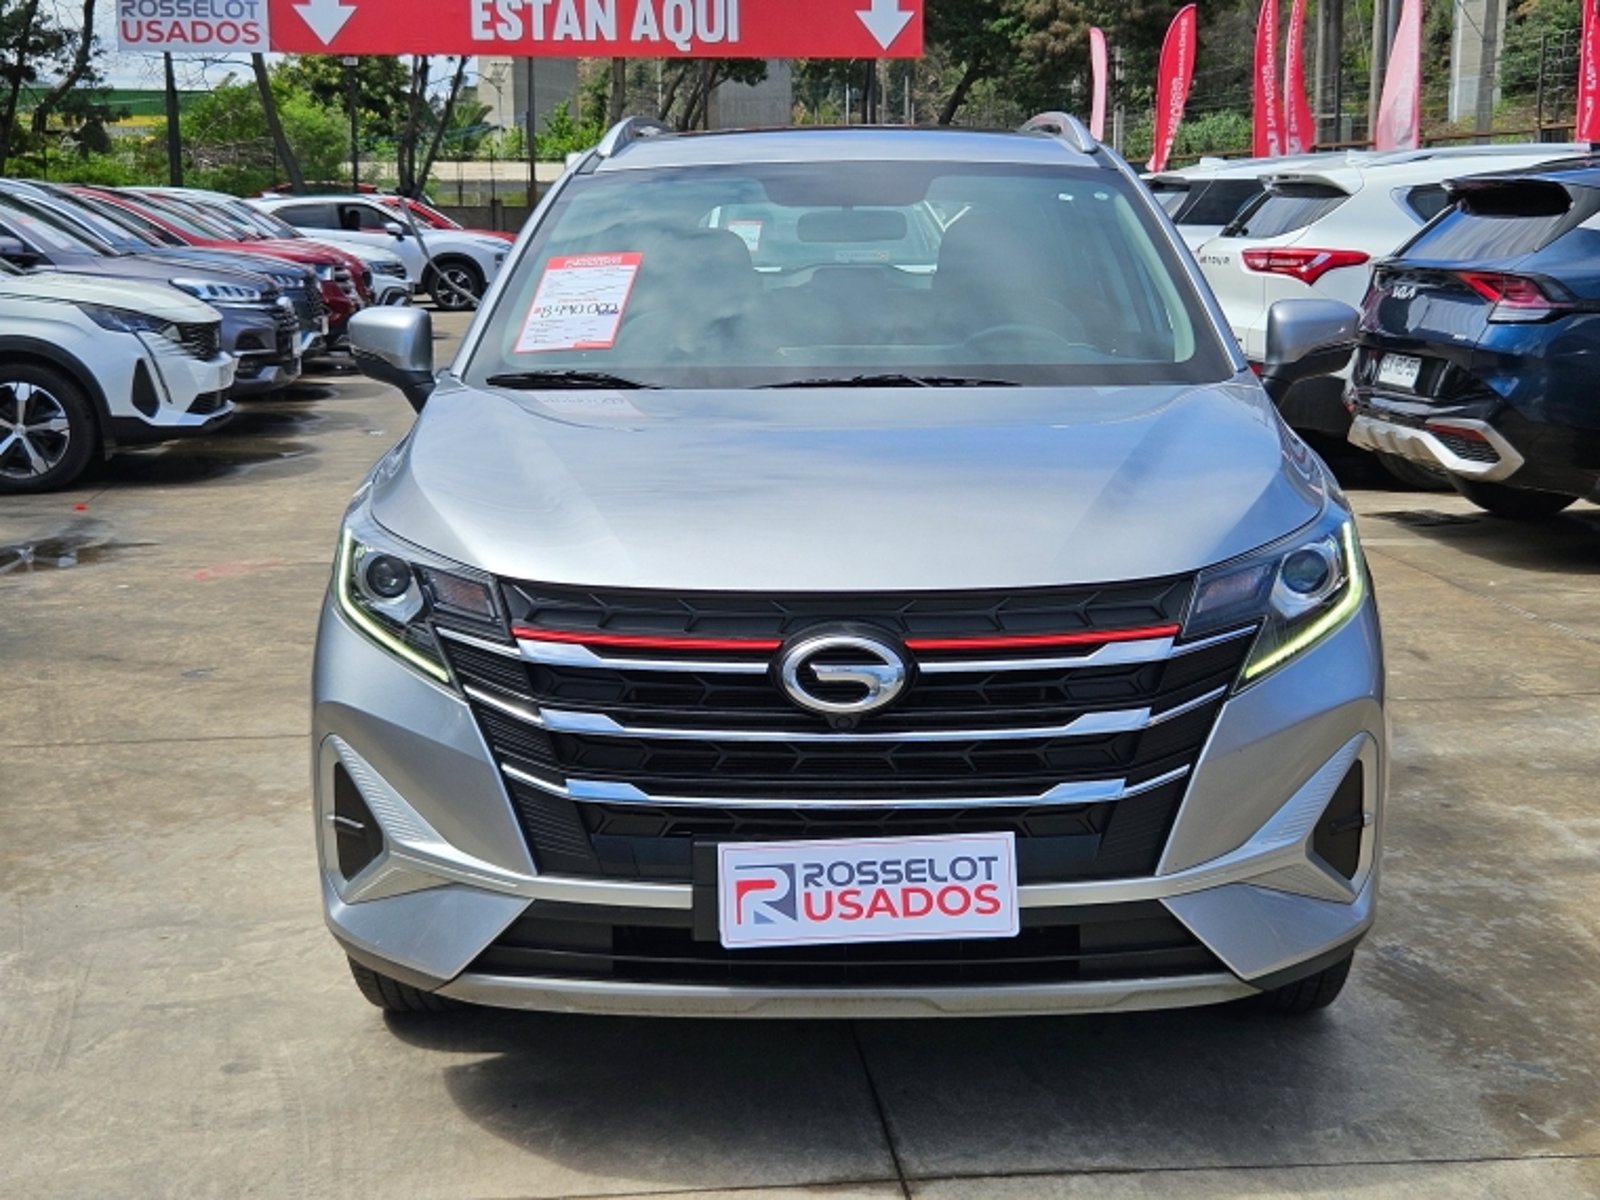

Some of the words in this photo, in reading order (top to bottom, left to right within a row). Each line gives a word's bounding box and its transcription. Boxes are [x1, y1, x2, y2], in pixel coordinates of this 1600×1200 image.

[120, 0, 258, 18] ROSSELOT
[121, 20, 260, 44] USADOS
[802, 856, 999, 887] ROSSELOT
[803, 884, 1001, 922] USADOS
